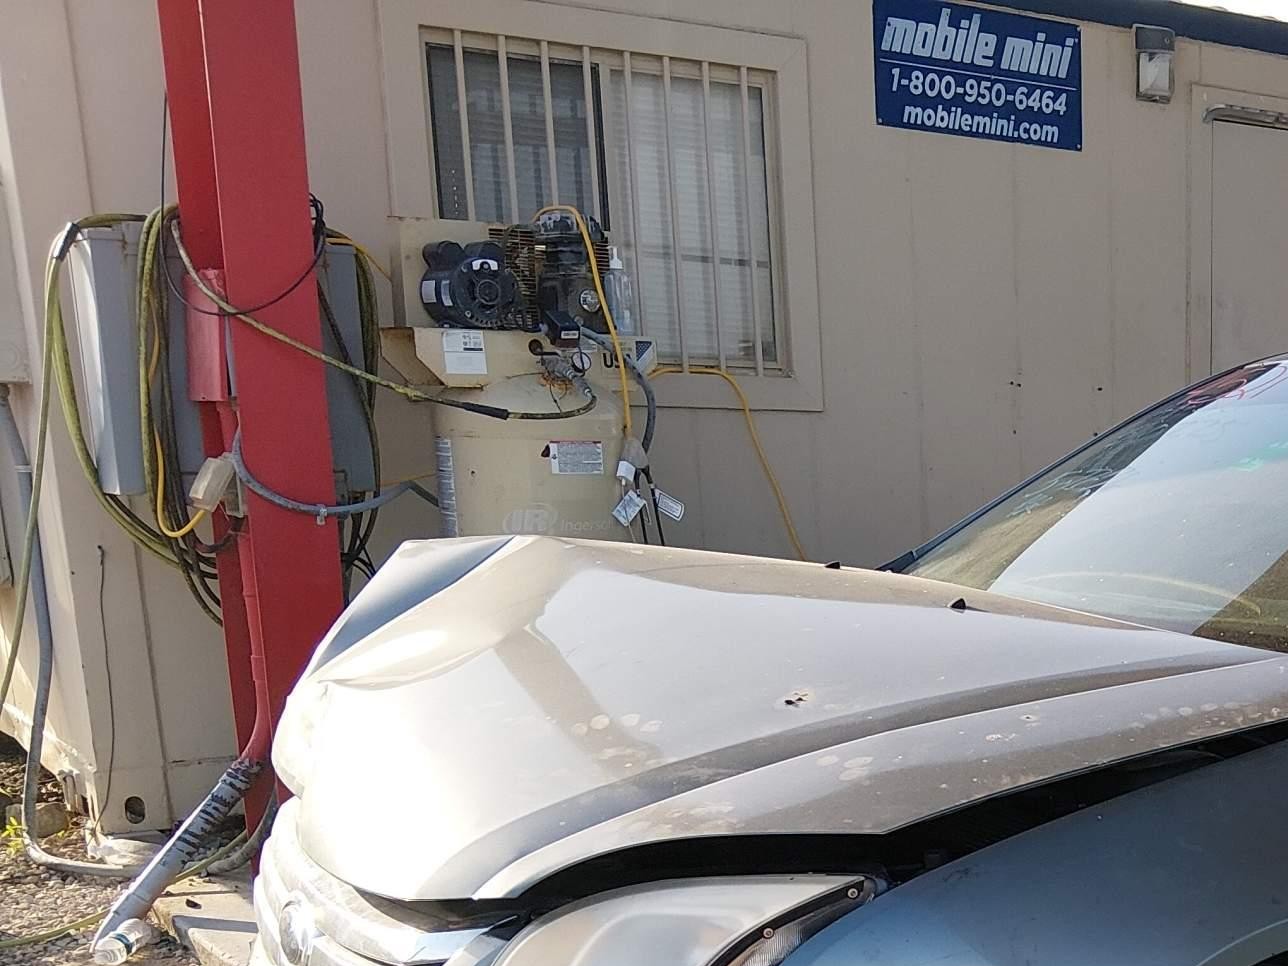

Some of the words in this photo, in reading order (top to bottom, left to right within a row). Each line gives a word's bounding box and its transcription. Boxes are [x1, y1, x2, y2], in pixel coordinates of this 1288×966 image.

[881, 8, 997, 67] mobile
[1000, 32, 1074, 79] mini
[891, 68, 1067, 115] 1-800-950-6464
[903, 104, 1059, 143] mobilemini.com
